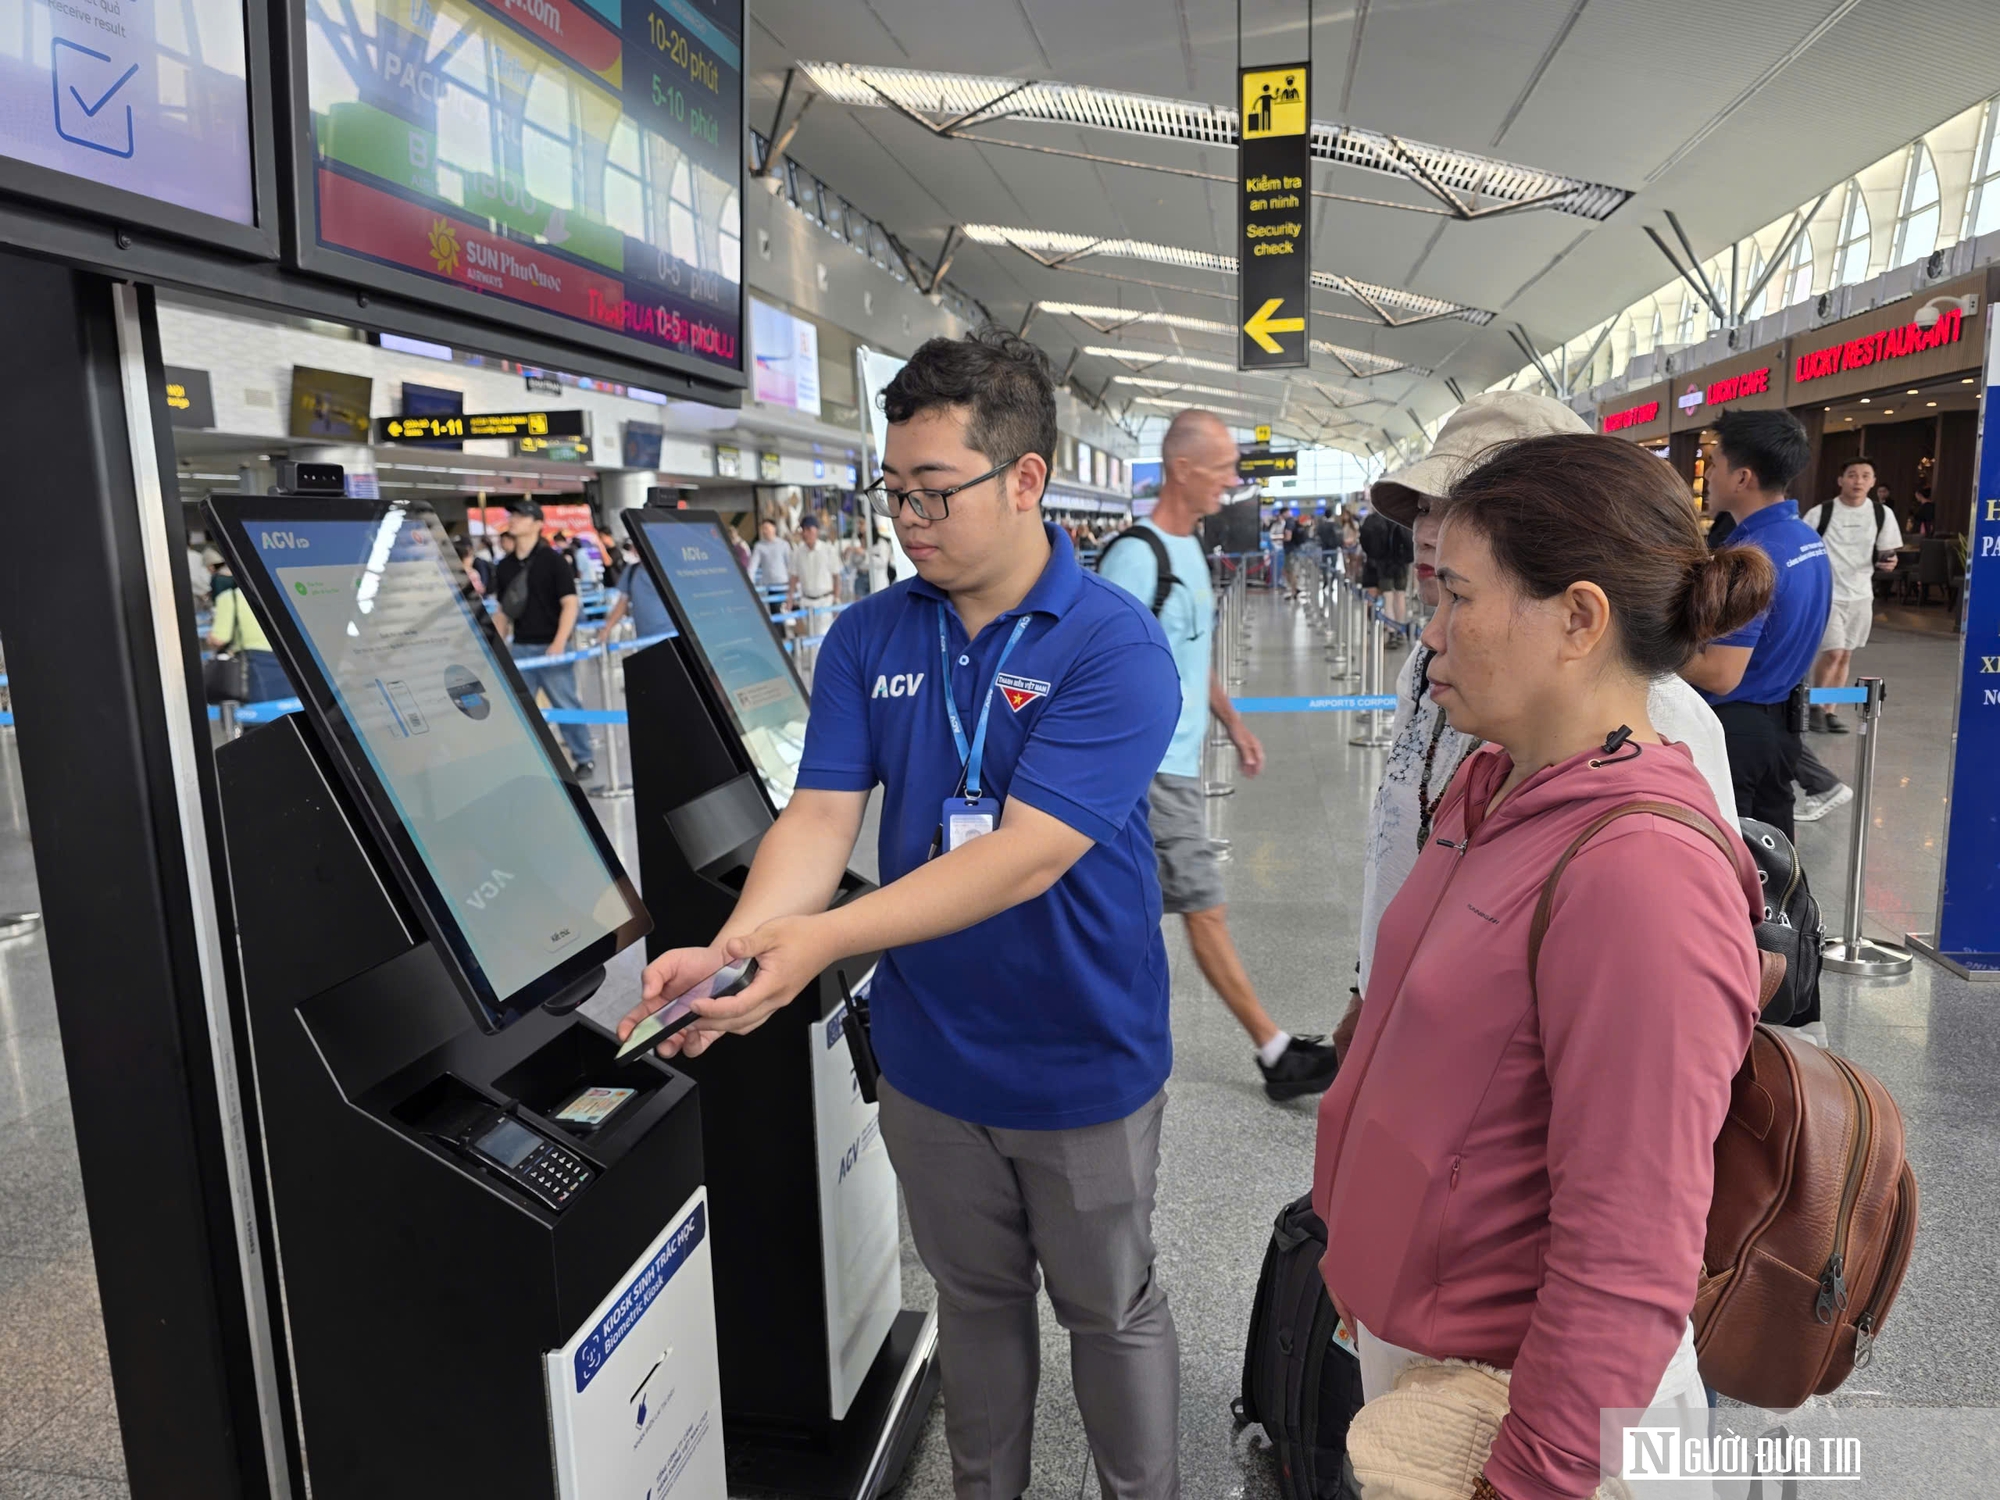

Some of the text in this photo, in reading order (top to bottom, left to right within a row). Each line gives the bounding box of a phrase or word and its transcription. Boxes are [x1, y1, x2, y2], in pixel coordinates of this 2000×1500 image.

[48, 0, 126, 38] Receive result
[648, 12, 689, 69] 10-20
[690, 50, 719, 94] phút
[653, 73, 685, 122] 5-10
[1246, 174, 1302, 193] Kiểm tra
[1250, 194, 1299, 212] an ninh
[466, 240, 499, 271] SUN
[1246, 222, 1301, 256] Security check
[1795, 307, 1963, 383] LUCKY RESTAURANT
[1706, 377, 1739, 406] LUCKY
[1739, 367, 1770, 398] CAFE
[261, 531, 295, 549] ACV
[1020, 615, 1031, 629] CV
[871, 673, 925, 698] ACV
[1309, 698, 1355, 708] AIRPORTS
[950, 715, 961, 734] ACV
[838, 1137, 860, 1185] ACV
[602, 1295, 634, 1337] KIOSK
[633, 1266, 655, 1301] SINH
[676, 1216, 695, 1243] HỌC
[603, 1275, 665, 1354] Biometric Kiosk
